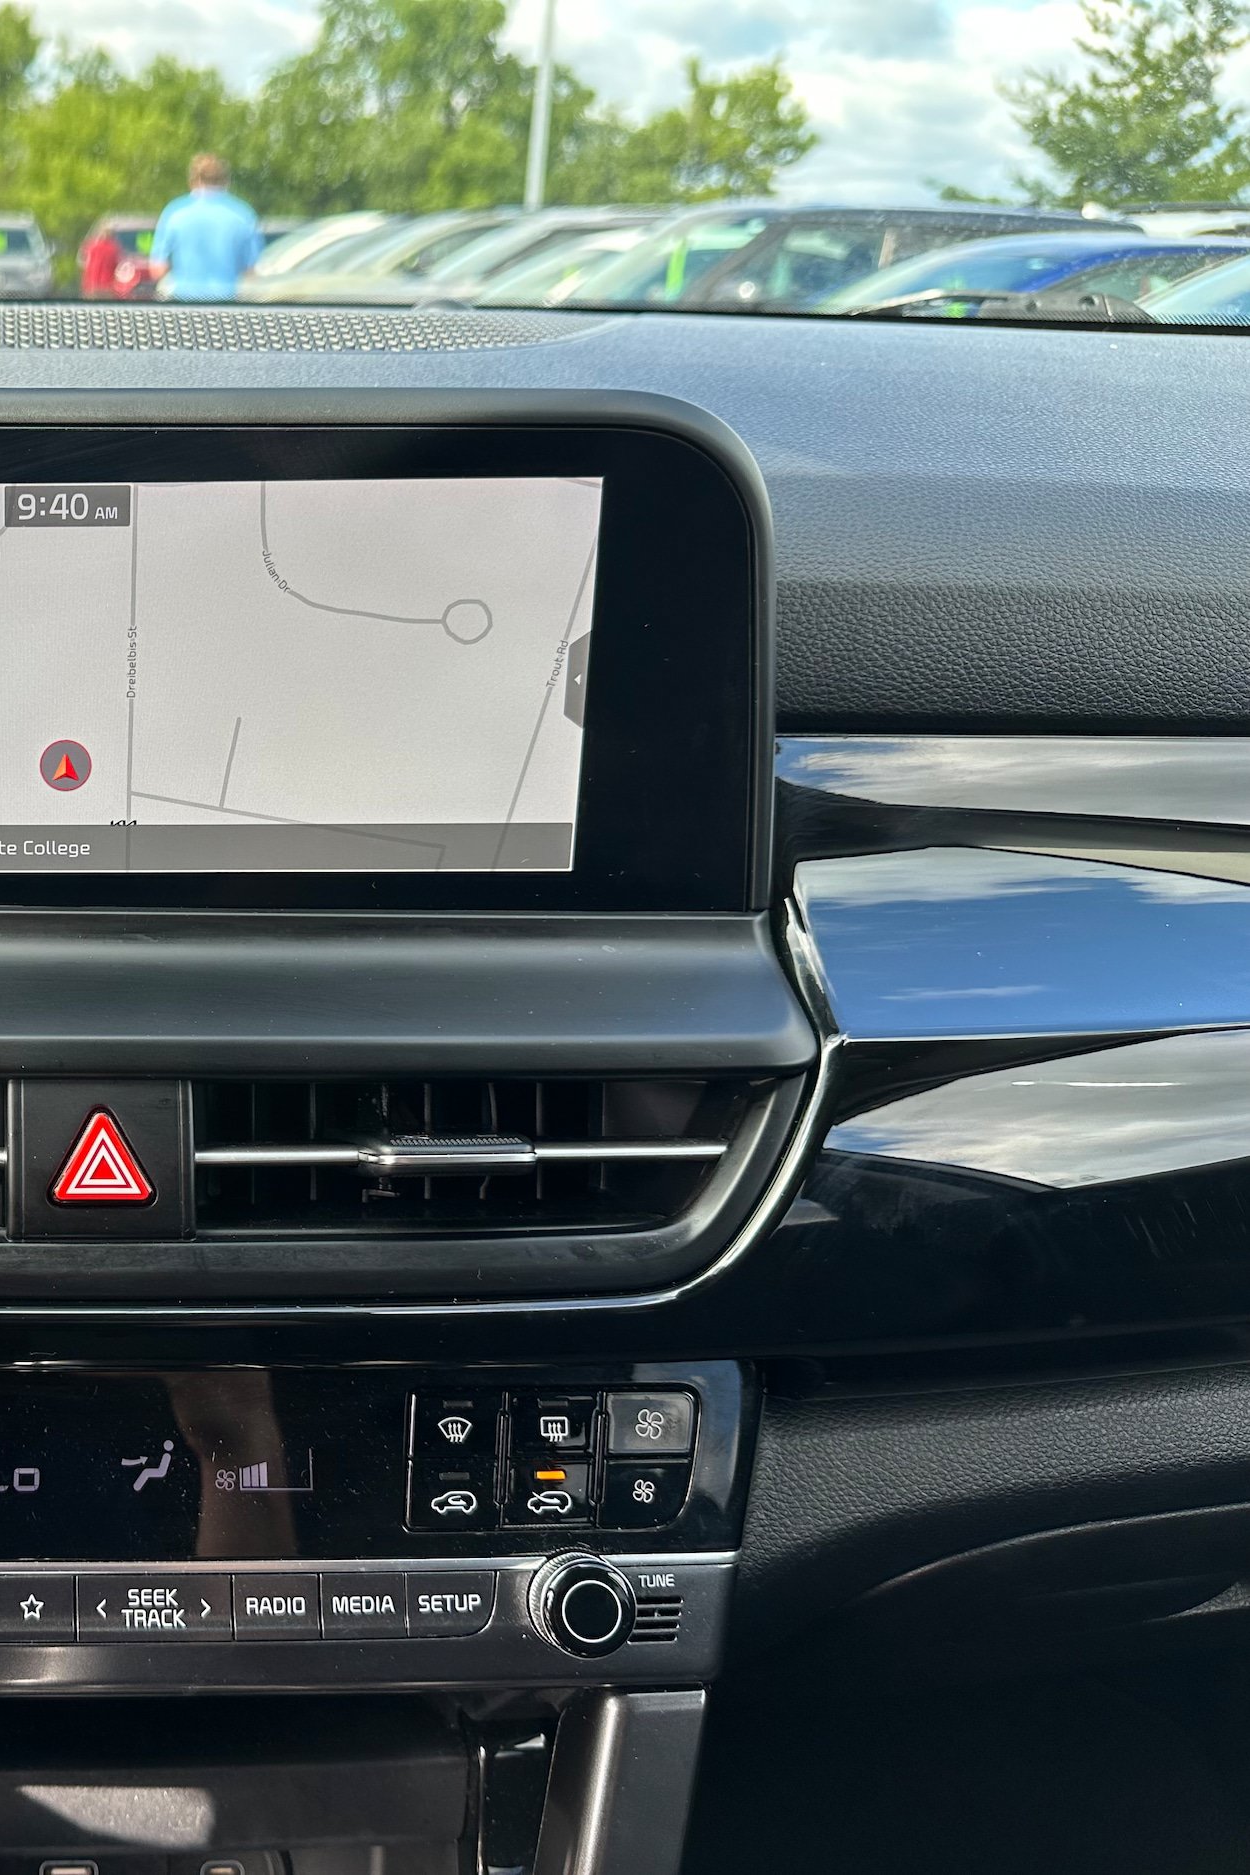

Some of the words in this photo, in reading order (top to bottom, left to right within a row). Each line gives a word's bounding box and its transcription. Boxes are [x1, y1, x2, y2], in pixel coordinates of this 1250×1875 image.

[17, 493, 89, 520] 9:40
[93, 506, 118, 520] AM
[262, 550, 280, 583] Julian
[277, 579, 291, 593] Dr
[127, 625, 137, 639] St
[126, 641, 137, 698] Dreibelbis
[546, 657, 565, 687] Trout
[556, 639, 569, 655] Rd
[23, 840, 91, 858] College
[639, 1572, 675, 1588] TUNE
[127, 1588, 178, 1606] SEEK
[246, 1596, 306, 1616] RADIO
[332, 1595, 396, 1615] MEDIA
[418, 1593, 481, 1613] SETUP
[121, 1608, 187, 1628] TRACK
